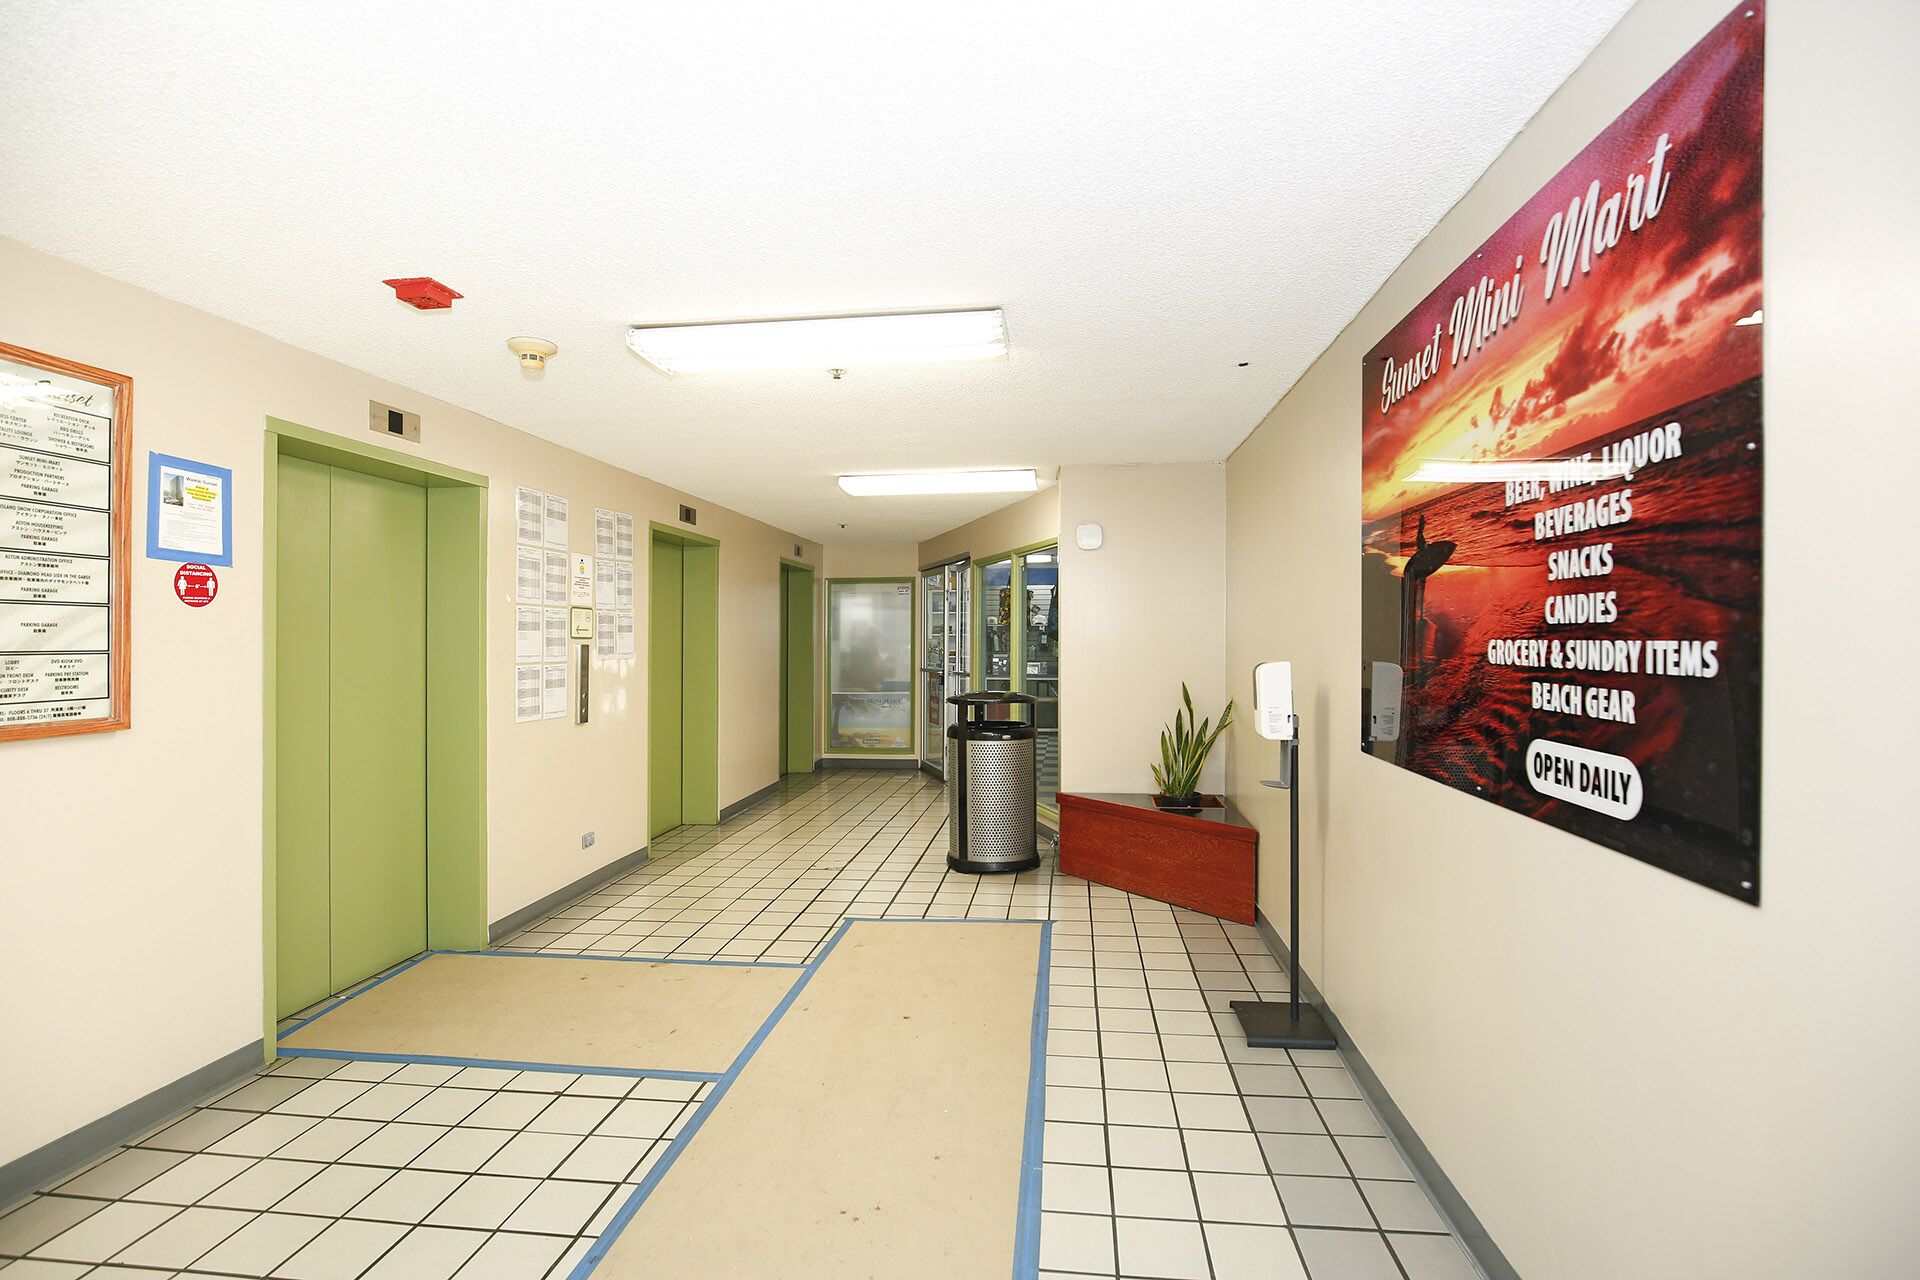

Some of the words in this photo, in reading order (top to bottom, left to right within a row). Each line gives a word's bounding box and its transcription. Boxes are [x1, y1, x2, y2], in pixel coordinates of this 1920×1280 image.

[1381, 322, 1443, 414] Sunset
[1449, 254, 1525, 366] Mini
[1540, 132, 1673, 300] Mart
[1602, 422, 1682, 481] LIQUOR
[14, 468, 43, 477] PRODUCTION
[44, 473, 65, 481] PARTNERS
[31, 522, 63, 530] HOUSEKEEPING
[32, 508, 62, 516] CORPORATION
[1534, 488, 1633, 541] BEVERAGES
[1548, 542, 1614, 581] SNACKS
[1544, 590, 1618, 625] CANDIES
[1487, 639, 1549, 669] GROCERY
[1550, 640, 1564, 670] &
[1564, 639, 1642, 675] SUNDRY
[1645, 640, 1719, 679] ITEMS
[1531, 681, 1582, 715] BEACH
[1585, 689, 1637, 725] GEAR
[1533, 750, 1575, 792] OPEN
[1579, 762, 1633, 806] DAILY
